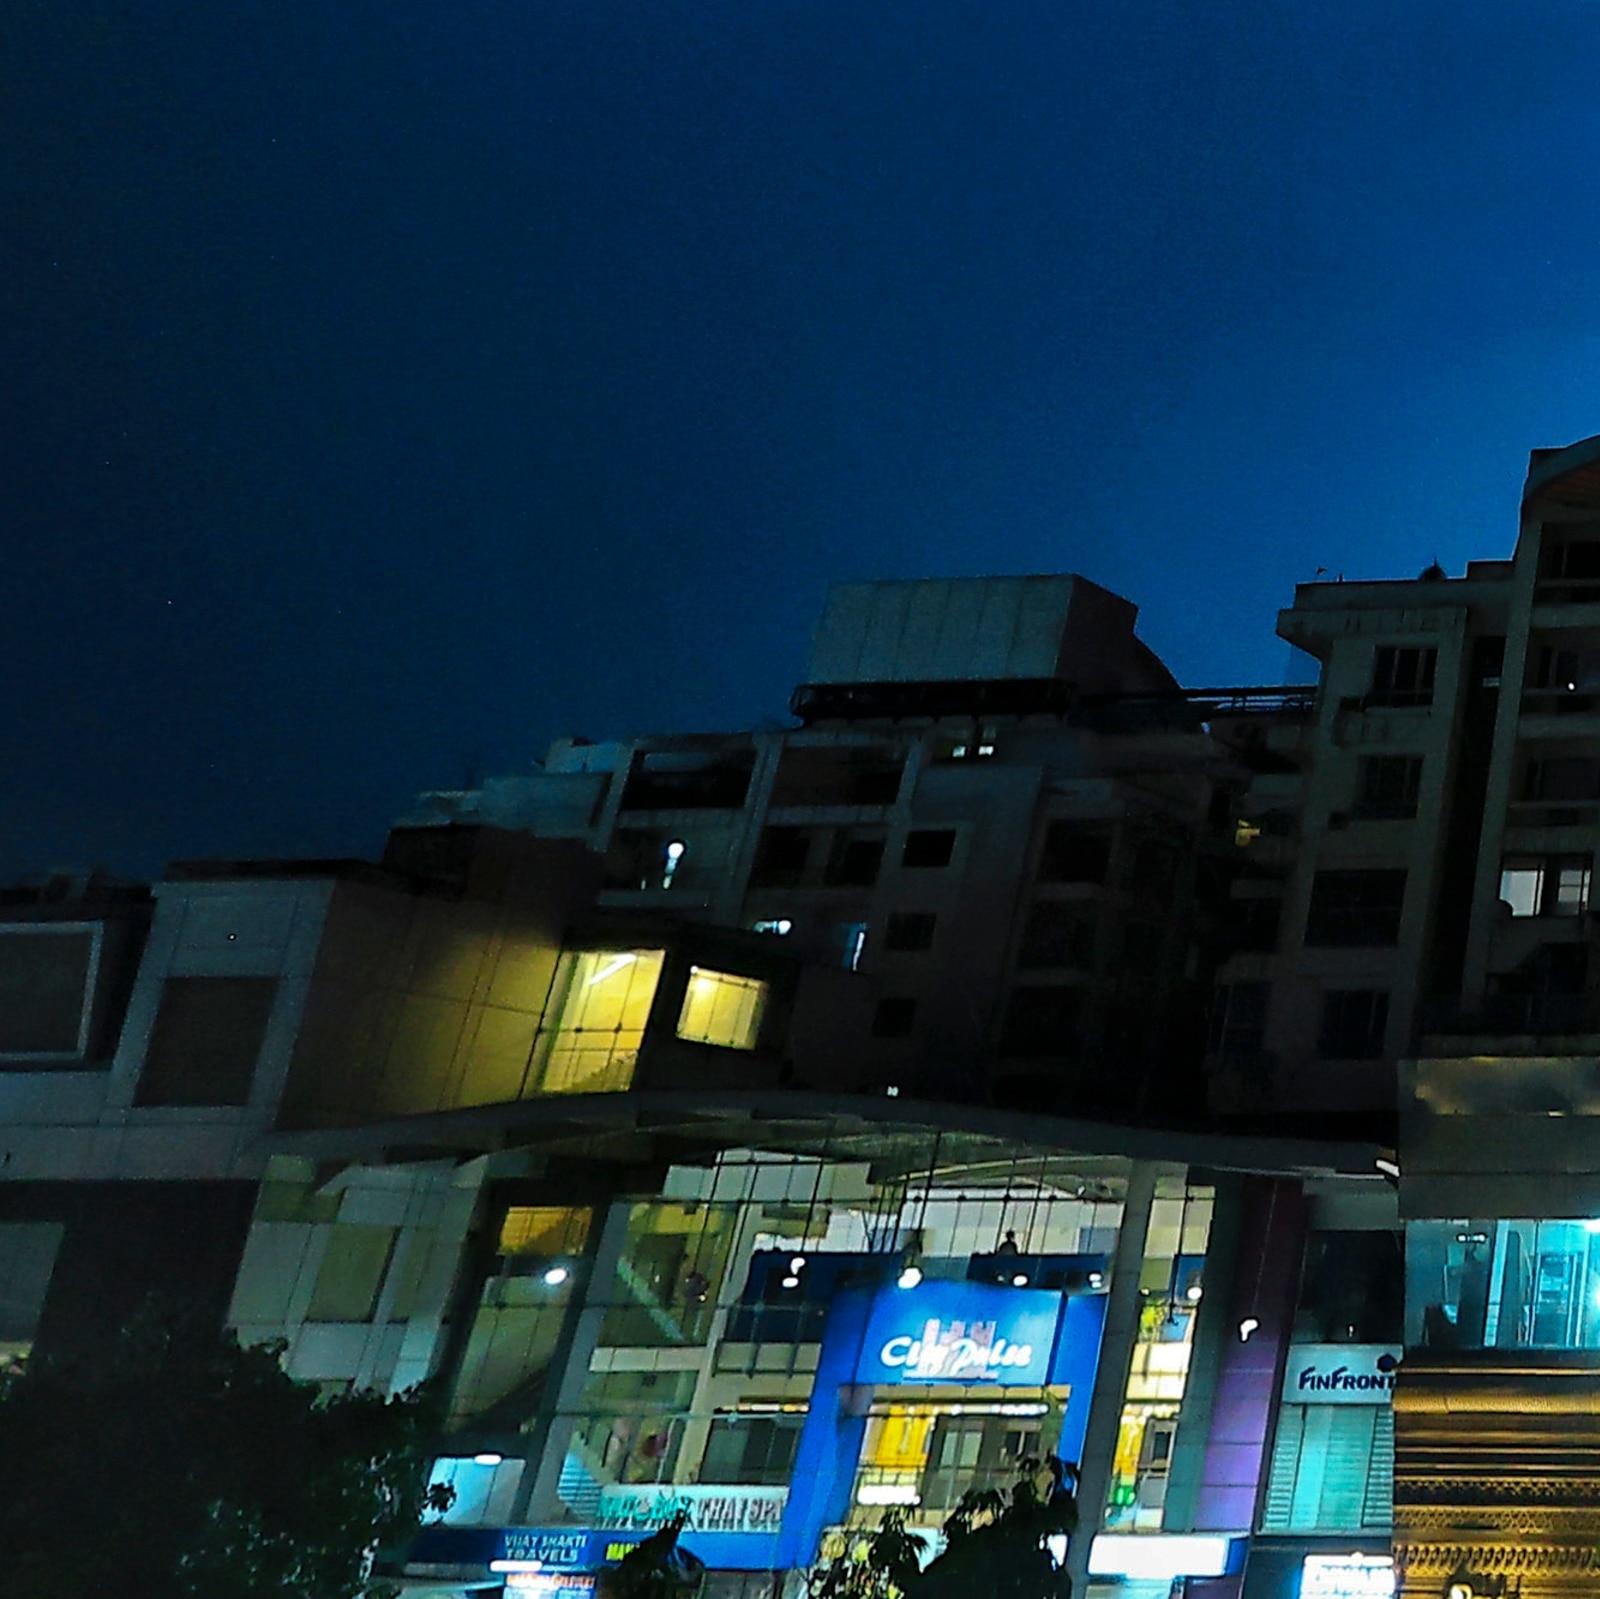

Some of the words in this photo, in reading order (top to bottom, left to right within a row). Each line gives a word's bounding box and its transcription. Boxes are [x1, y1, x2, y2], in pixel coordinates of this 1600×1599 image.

[504, 1534, 538, 1548] VIJAY
[541, 1534, 587, 1548] SHAKTI
[506, 1548, 579, 1563] TRAVELS
